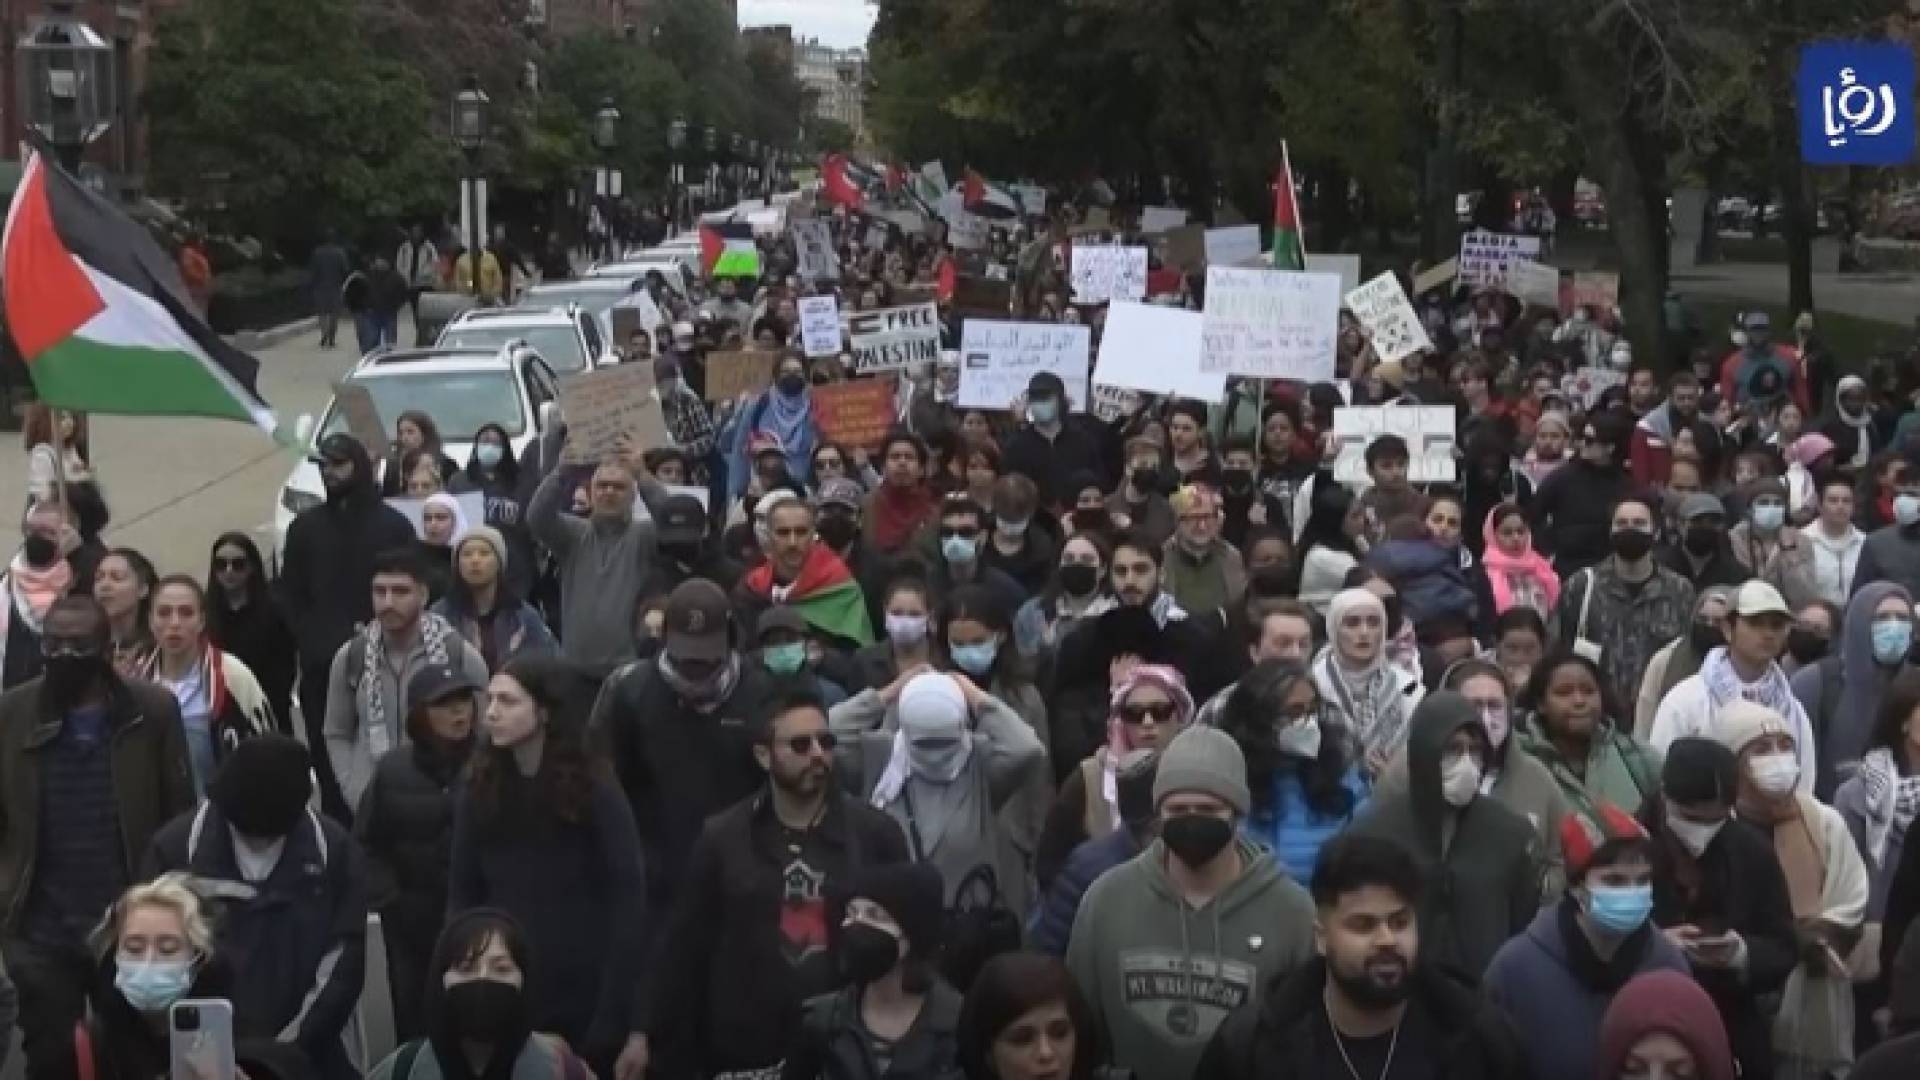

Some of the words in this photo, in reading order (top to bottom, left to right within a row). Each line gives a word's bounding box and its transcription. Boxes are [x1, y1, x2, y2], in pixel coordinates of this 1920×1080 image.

[886, 307, 932, 330] FREE
[855, 337, 938, 367] PALESTINE
[1358, 409, 1435, 433] STOP
